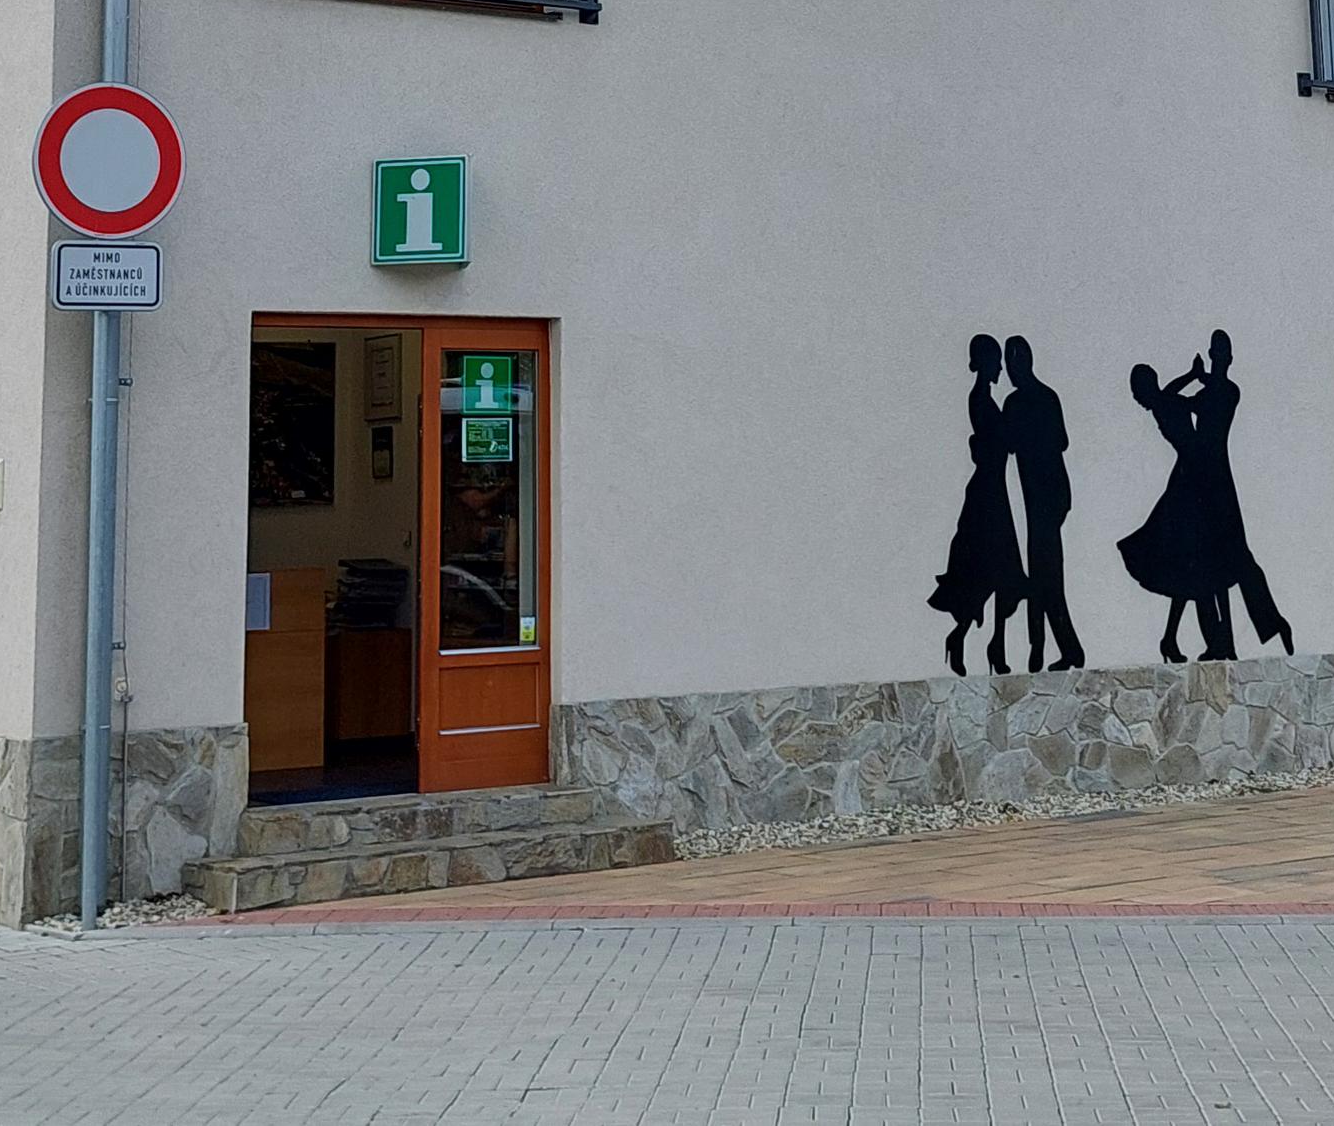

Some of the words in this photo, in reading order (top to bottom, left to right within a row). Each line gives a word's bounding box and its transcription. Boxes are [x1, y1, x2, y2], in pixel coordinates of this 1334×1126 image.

[93, 252, 121, 263] MIMO
[69, 267, 143, 280] ZAMĚSTNANCŮ
[65, 286, 72, 296] A
[75, 283, 146, 297] ÚČINKUJÍCÍCH
